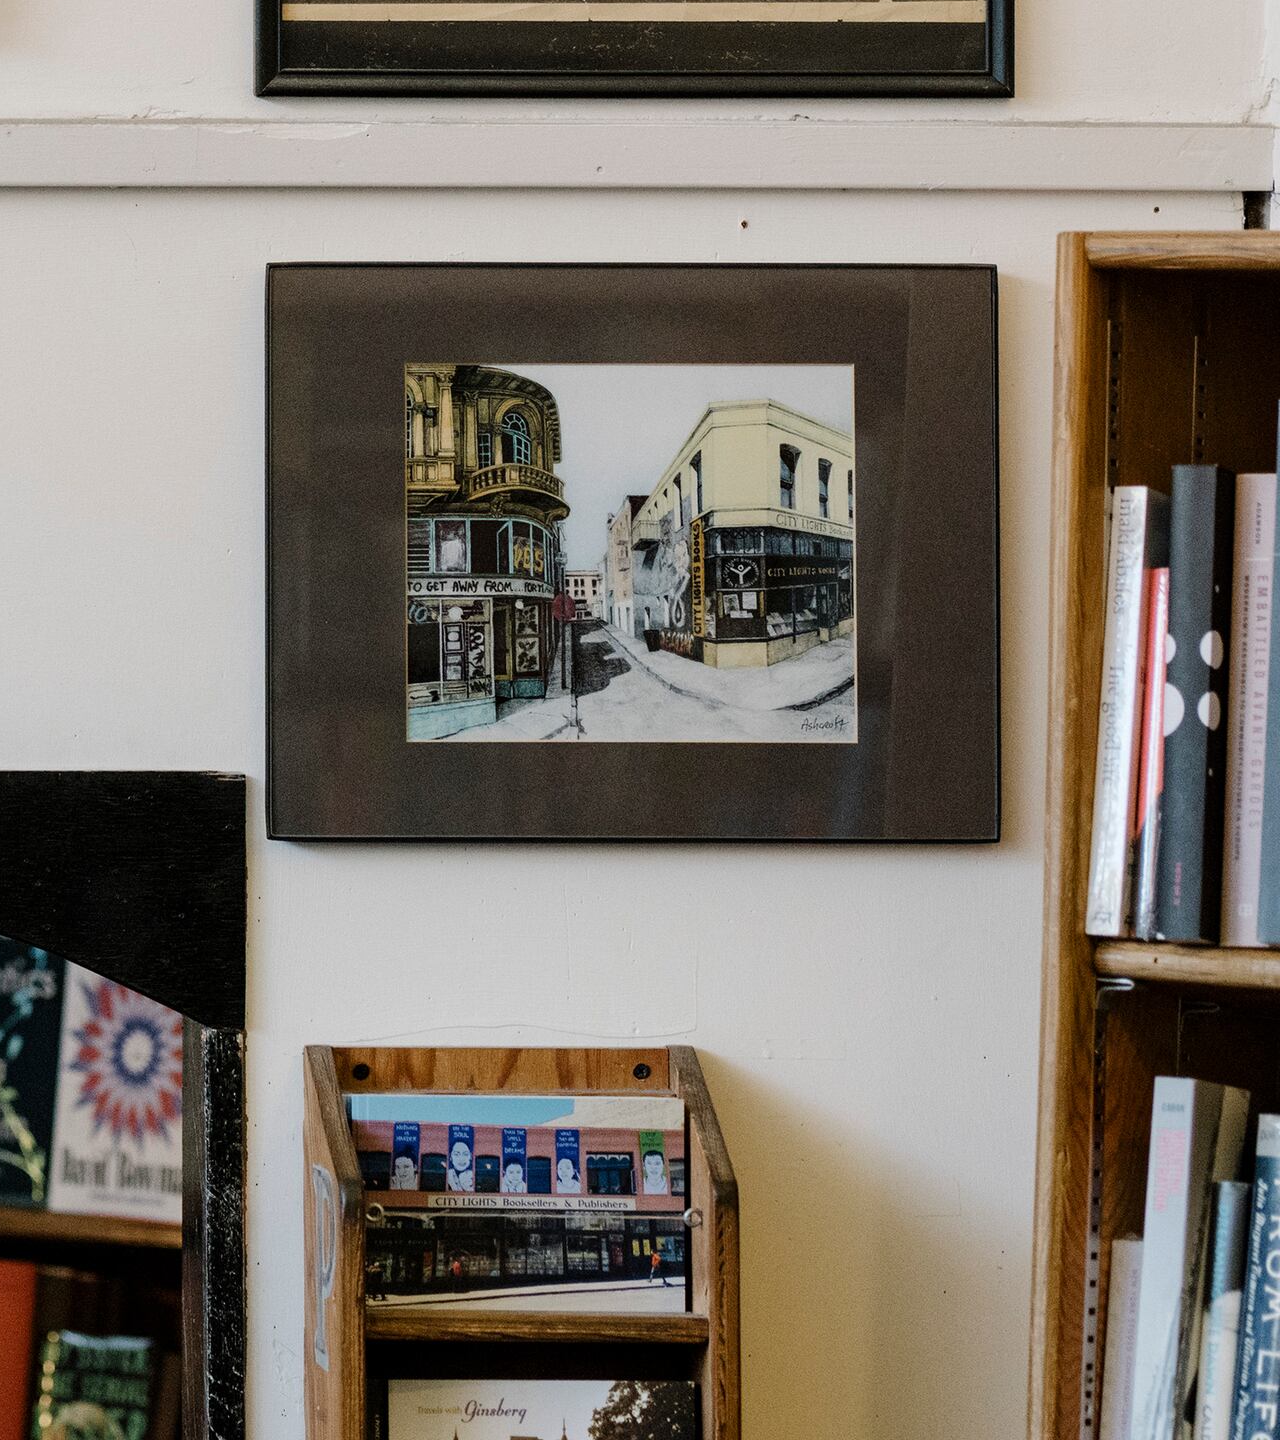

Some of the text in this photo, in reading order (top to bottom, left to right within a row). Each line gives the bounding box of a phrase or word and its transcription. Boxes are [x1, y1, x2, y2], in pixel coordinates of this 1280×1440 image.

[776, 513, 827, 533] CITY LIGHTS
[692, 523, 702, 635] CITY LIGHTS BOOKS
[767, 567, 786, 577] CITY
[789, 567, 817, 576] LIGHTS
[407, 583, 422, 593] TO
[427, 581, 447, 592] GET
[452, 581, 479, 593] AWAY
[1249, 574, 1269, 829] EMBATTLED AVANT-GARDES
[435, 1197, 628, 1209] CITY LIGHTS Booksellers & Publishers
[1256, 1178, 1268, 1210] Julia
[1251, 1212, 1266, 1265] Margaret
[1245, 1313, 1254, 1335] and
[1240, 1337, 1255, 1387] Victorian
[460, 1397, 527, 1424] Ginsberg
